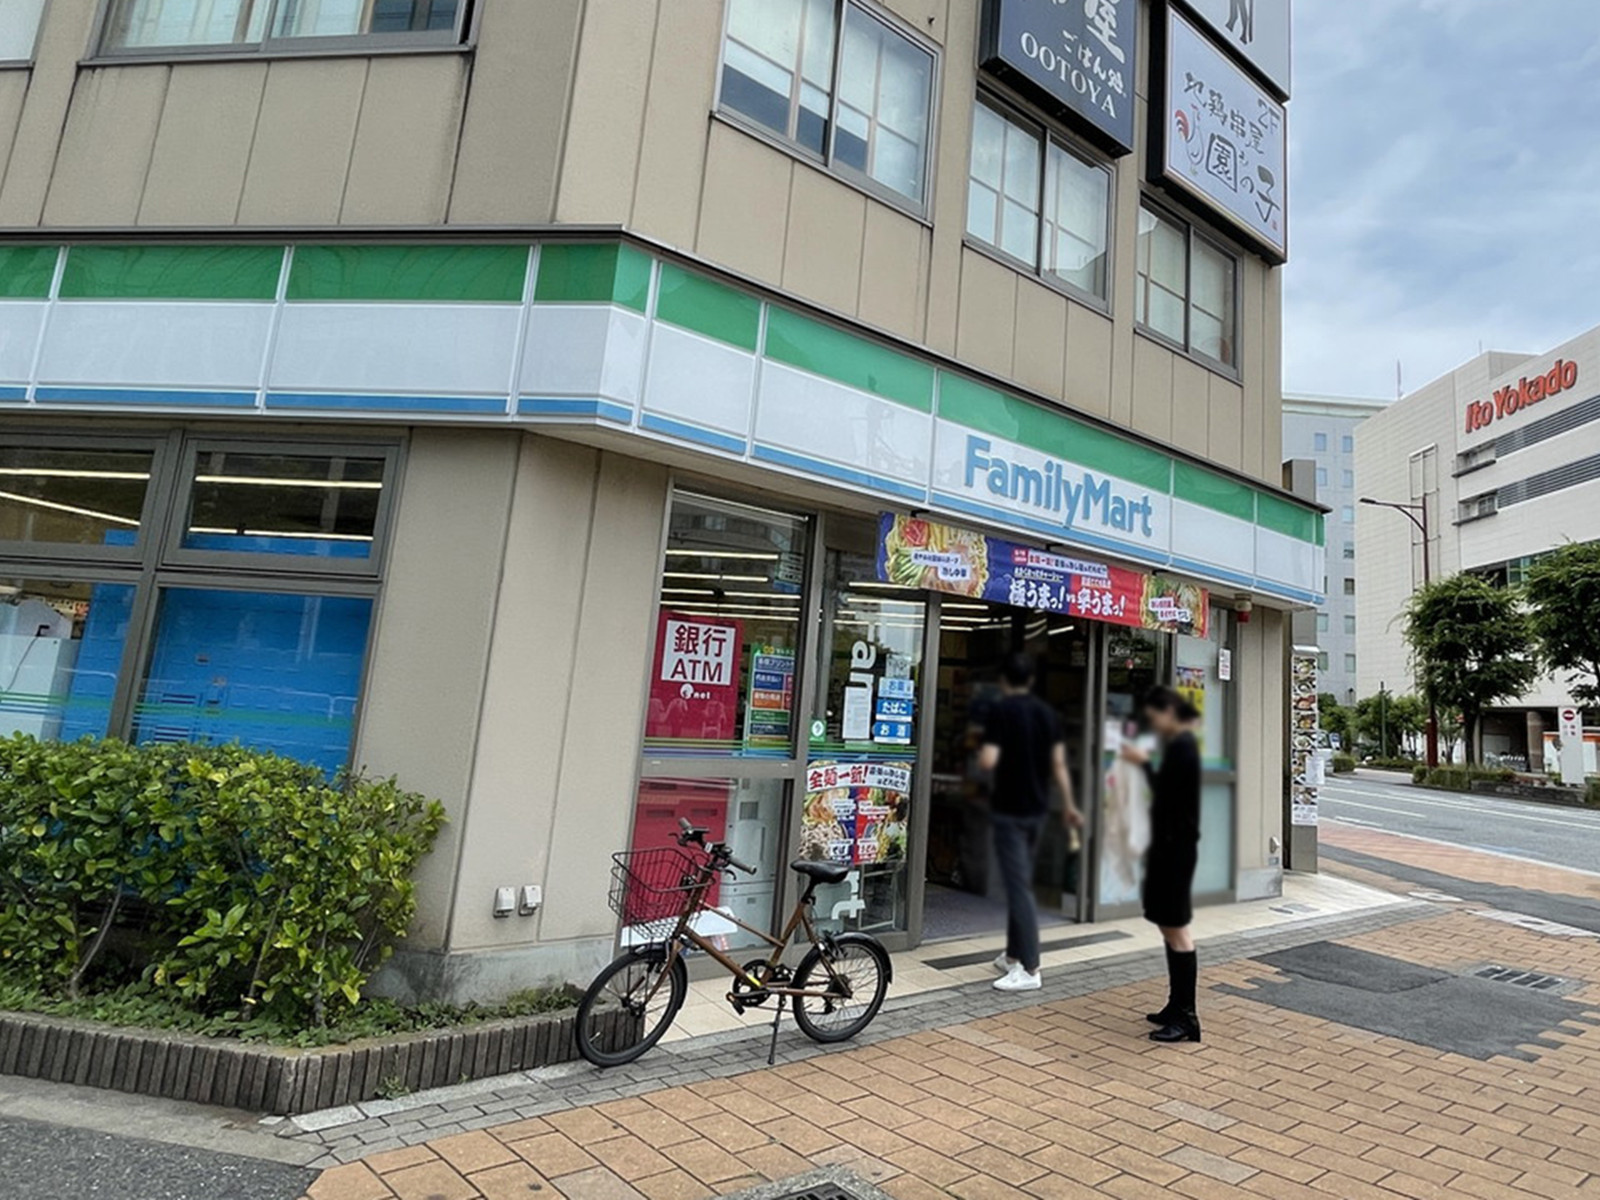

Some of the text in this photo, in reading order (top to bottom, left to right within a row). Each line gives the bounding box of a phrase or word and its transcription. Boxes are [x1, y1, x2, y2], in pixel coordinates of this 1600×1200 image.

[1020, 31, 1117, 119] OOTOYA
[1465, 358, 1578, 434] Ito Yokado
[964, 434, 1153, 538] FamilyMart
[674, 624, 727, 657] 銀行
[670, 658, 722, 682] ATM
[882, 701, 908, 715] たばこ
